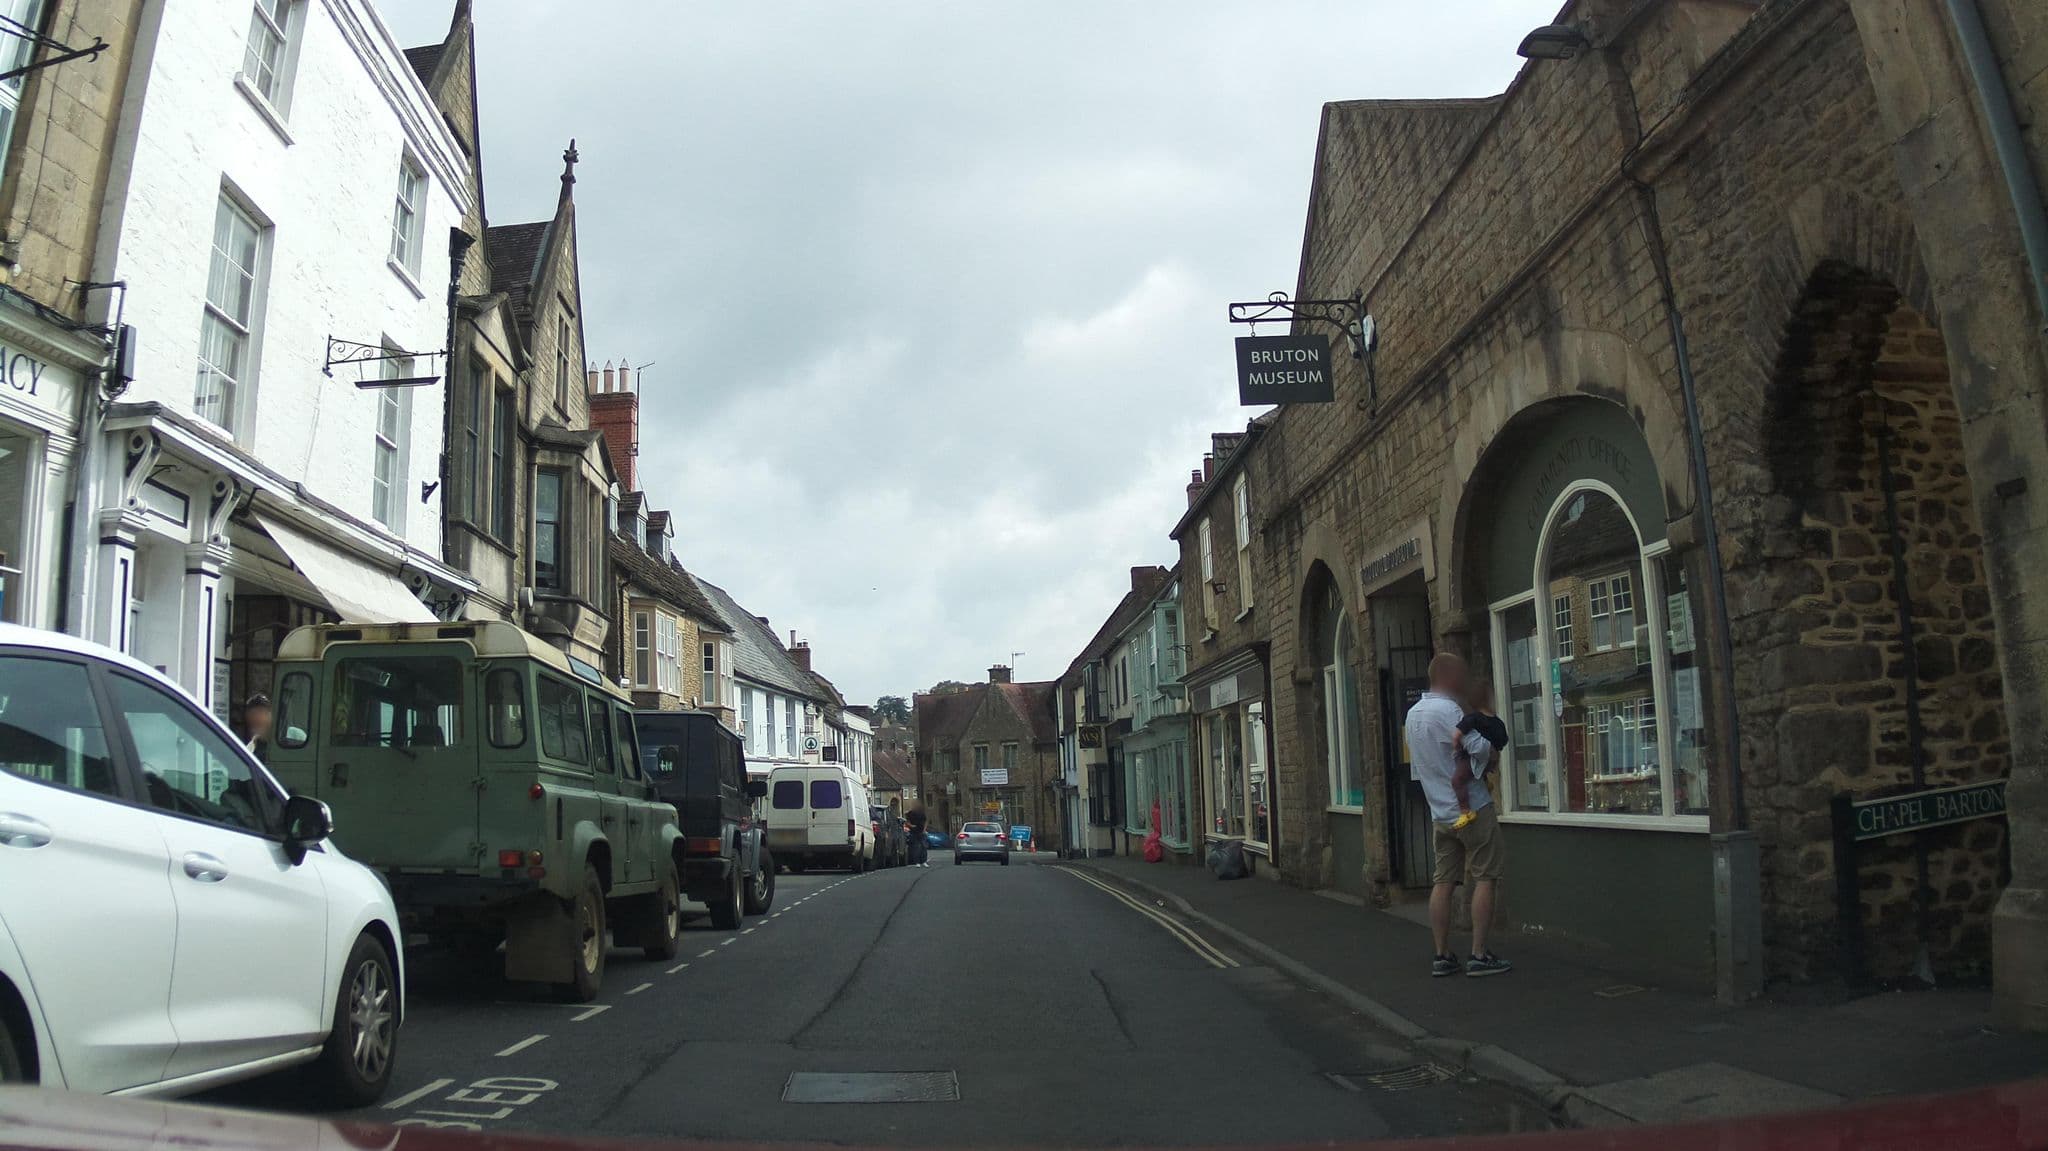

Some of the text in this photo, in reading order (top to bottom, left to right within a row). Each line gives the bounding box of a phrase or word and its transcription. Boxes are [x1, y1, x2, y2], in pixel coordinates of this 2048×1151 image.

[1251, 348, 1319, 365] BRUTON
[1249, 370, 1323, 386] MUSEUM
[1527, 437, 1632, 530] COMMUNITY OFFICE
[1858, 788, 2004, 832] CHAPEL BARTON
